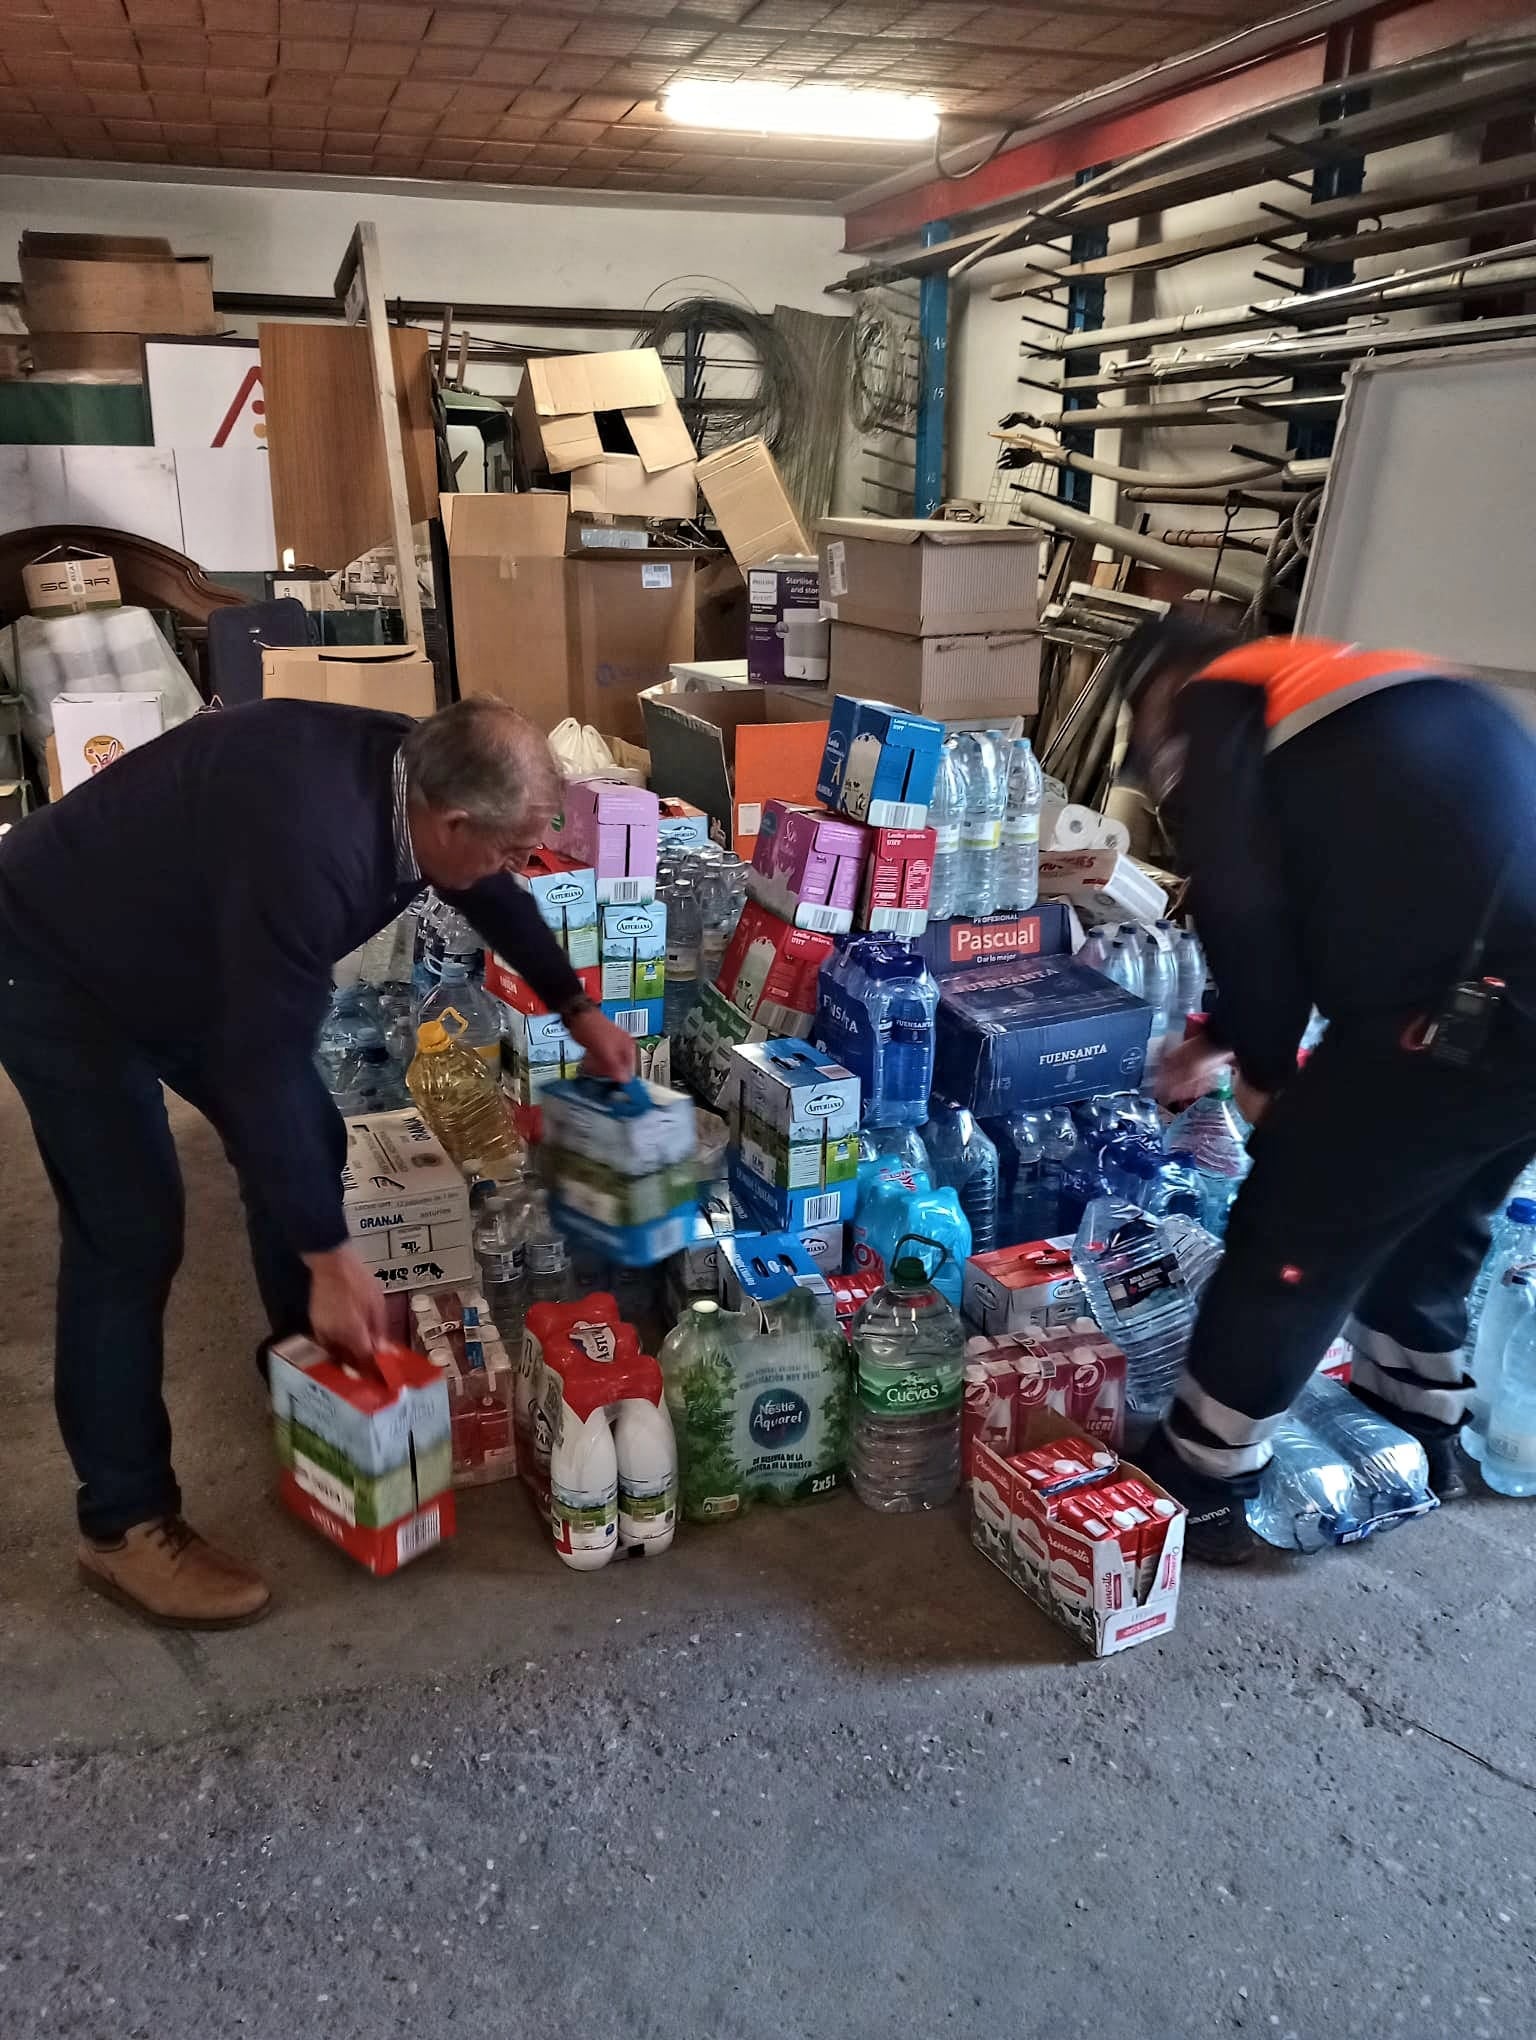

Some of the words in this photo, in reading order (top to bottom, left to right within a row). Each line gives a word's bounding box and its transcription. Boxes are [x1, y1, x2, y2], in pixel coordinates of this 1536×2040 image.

[804, 587, 819, 595] stor
[957, 924, 1034, 952] Pascual
[996, 953, 1017, 964] mejor
[1039, 1042, 1108, 1066] FUENSANTA
[360, 1213, 404, 1229] GRANJA
[753, 1411, 803, 1432] Aquarel
